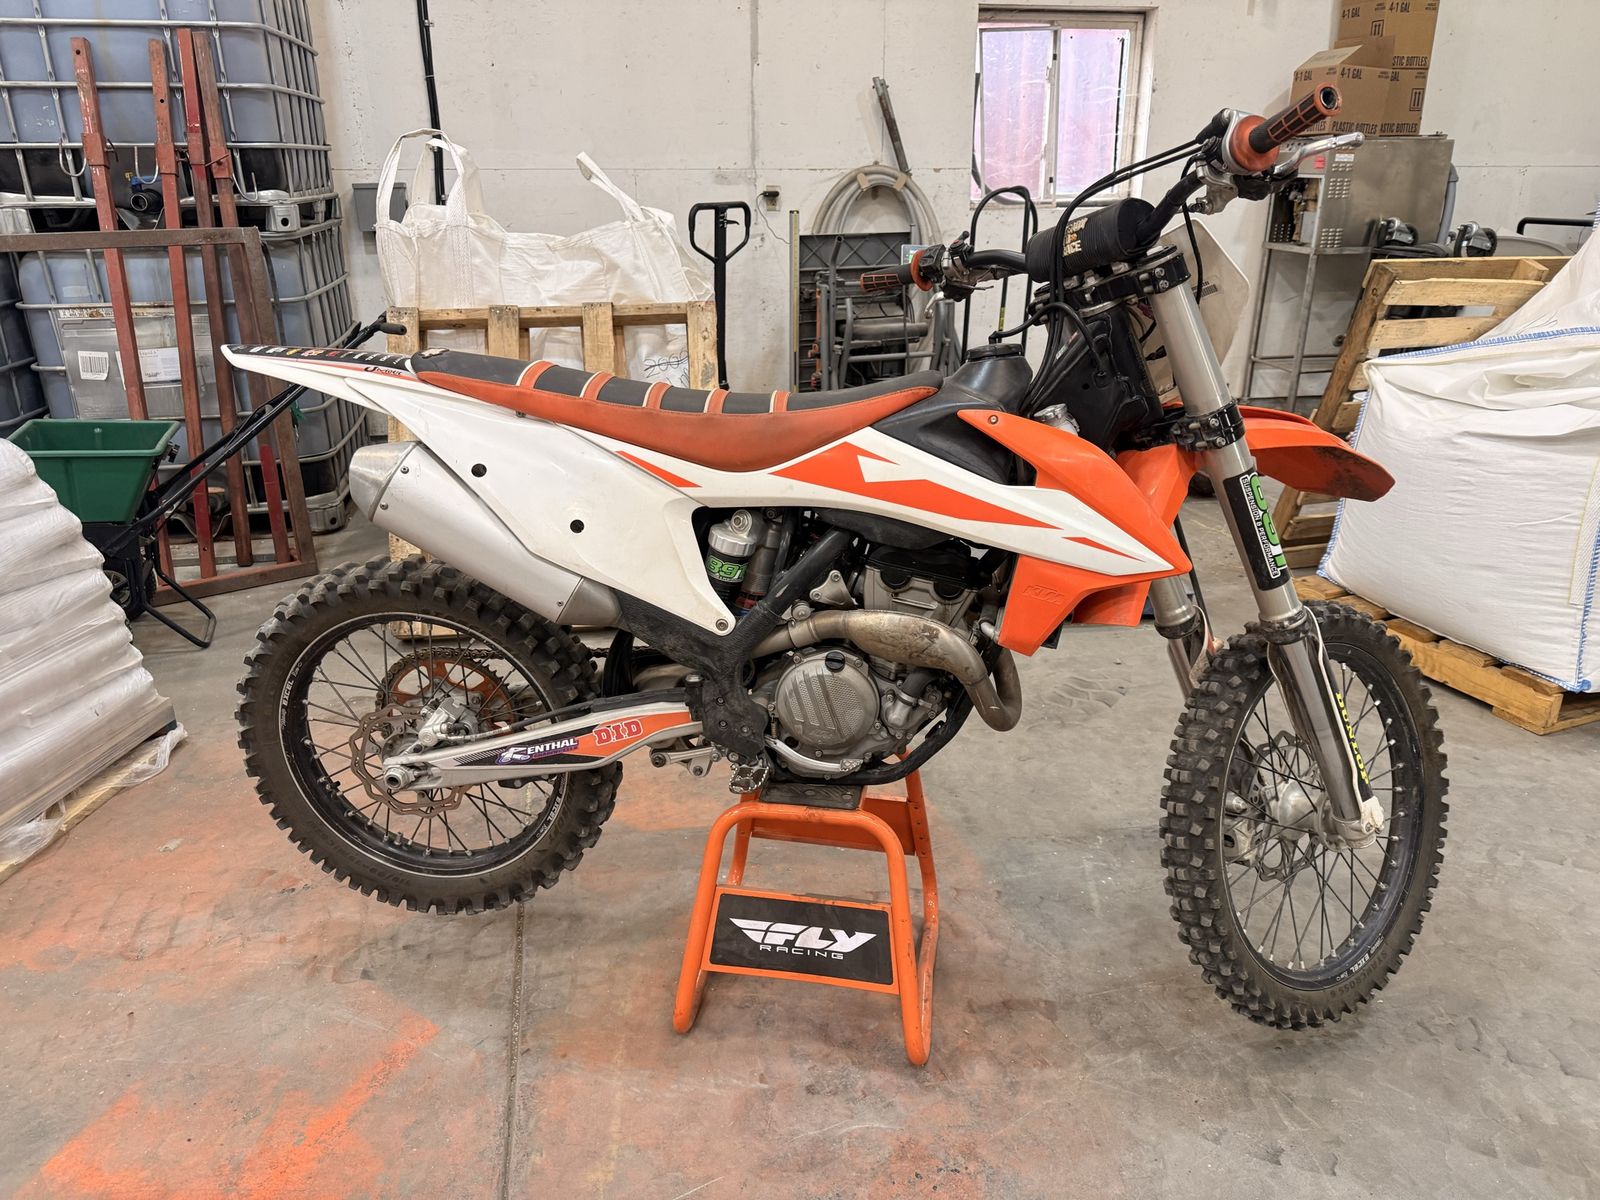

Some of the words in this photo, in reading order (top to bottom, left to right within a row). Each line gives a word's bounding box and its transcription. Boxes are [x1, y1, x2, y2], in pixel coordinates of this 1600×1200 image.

[1351, 7, 1360, 18] GAL
[1389, 2, 1399, 13] 4-1
[1400, 2, 1410, 13] GAL
[1392, 56, 1405, 67] STIC
[1406, 56, 1428, 67] BOTTLES
[1340, 67, 1350, 79] 4-1
[1351, 68, 1362, 80] GAL
[1390, 71, 1400, 82] GAL
[1332, 121, 1354, 133] PLASTIC
[1355, 122, 1378, 134] BOTTLES
[1396, 123, 1418, 133] BOTTLES
[1241, 478, 1260, 521] SUSPENSION
[1258, 526, 1280, 576] PERFORMANCE
[1336, 692, 1370, 785] DUNLOP
[735, 918, 877, 953] FLY
[759, 944, 844, 960] RACING
[1350, 953, 1370, 973] EXCEL
